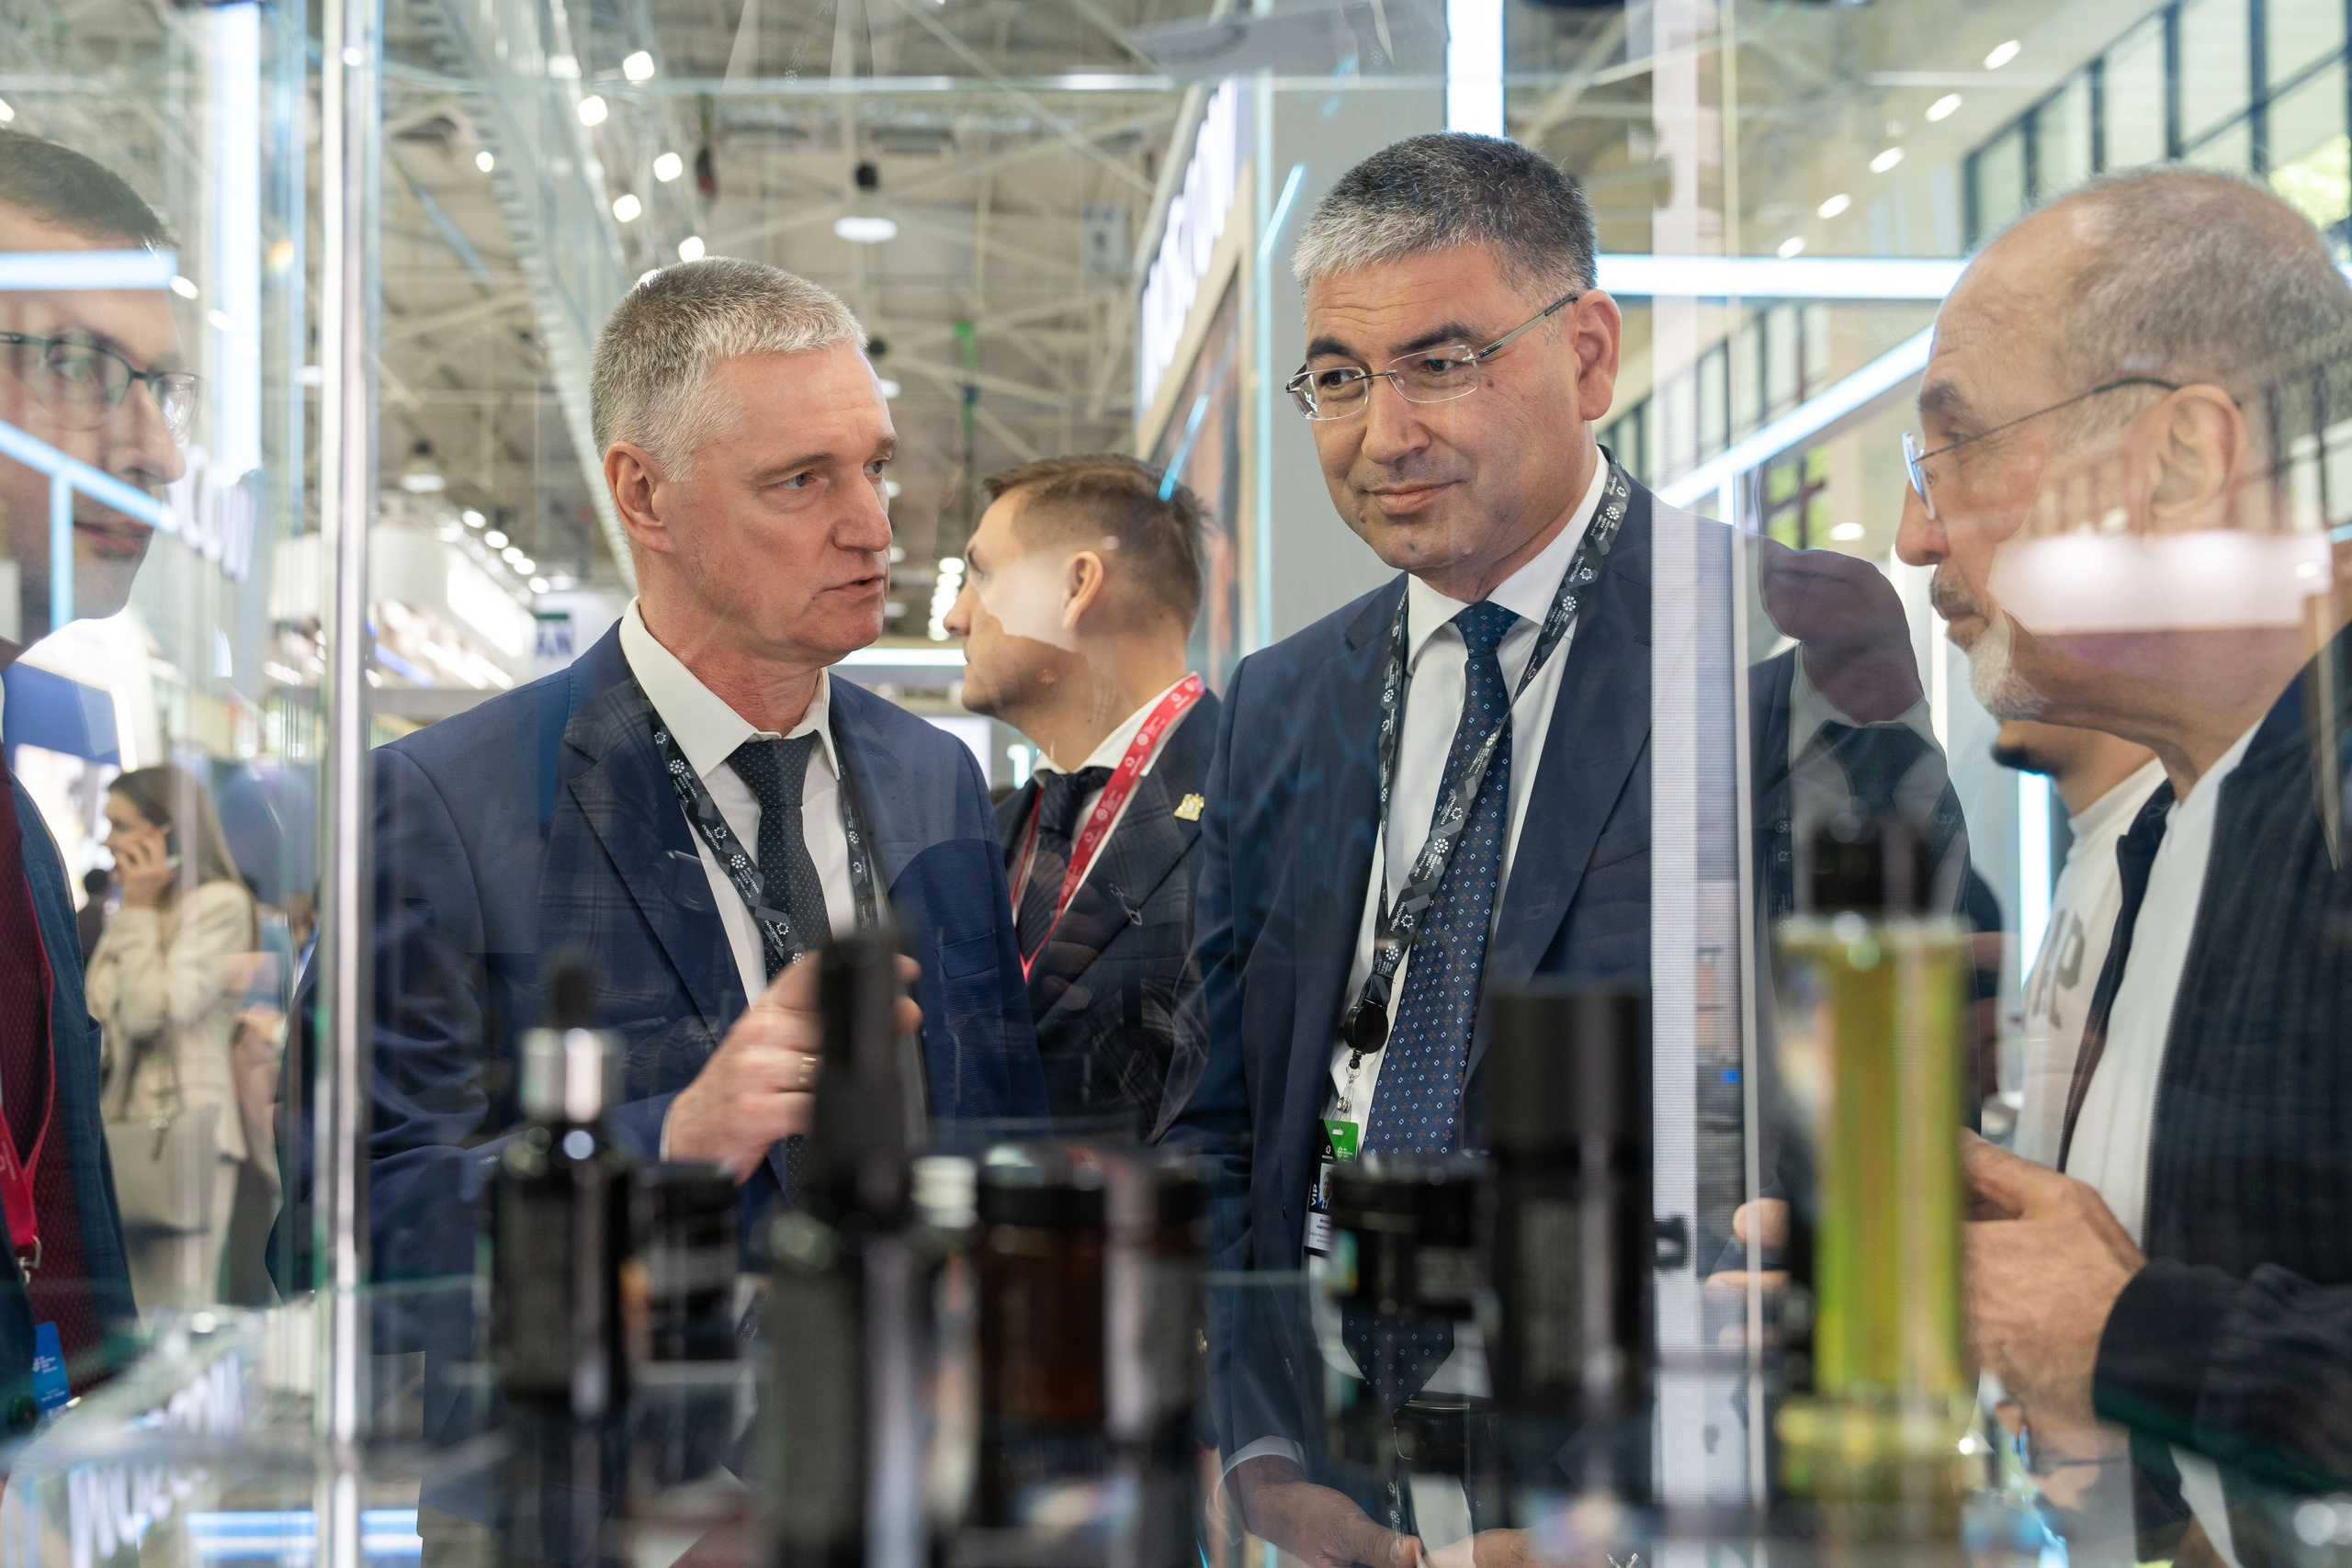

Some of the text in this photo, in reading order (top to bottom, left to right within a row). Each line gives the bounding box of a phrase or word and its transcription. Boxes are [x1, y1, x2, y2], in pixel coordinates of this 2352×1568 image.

[1568, 555, 1585, 583] INNOPROM
[677, 776, 686, 790] WEEK
[681, 773, 698, 799] INDUSTRIAL
[1440, 795, 1457, 825] INNOPROM
[701, 823, 721, 851] INNOPROM
[739, 871, 749, 885] WEEK
[1423, 854, 1439, 881] INDUSTRIAL
[743, 869, 761, 894] INDUSTRIAL
[1390, 901, 1407, 931] INNOPROM
[763, 919, 785, 947] INNOPROM
[1310, 1183, 1318, 1207] VIP
